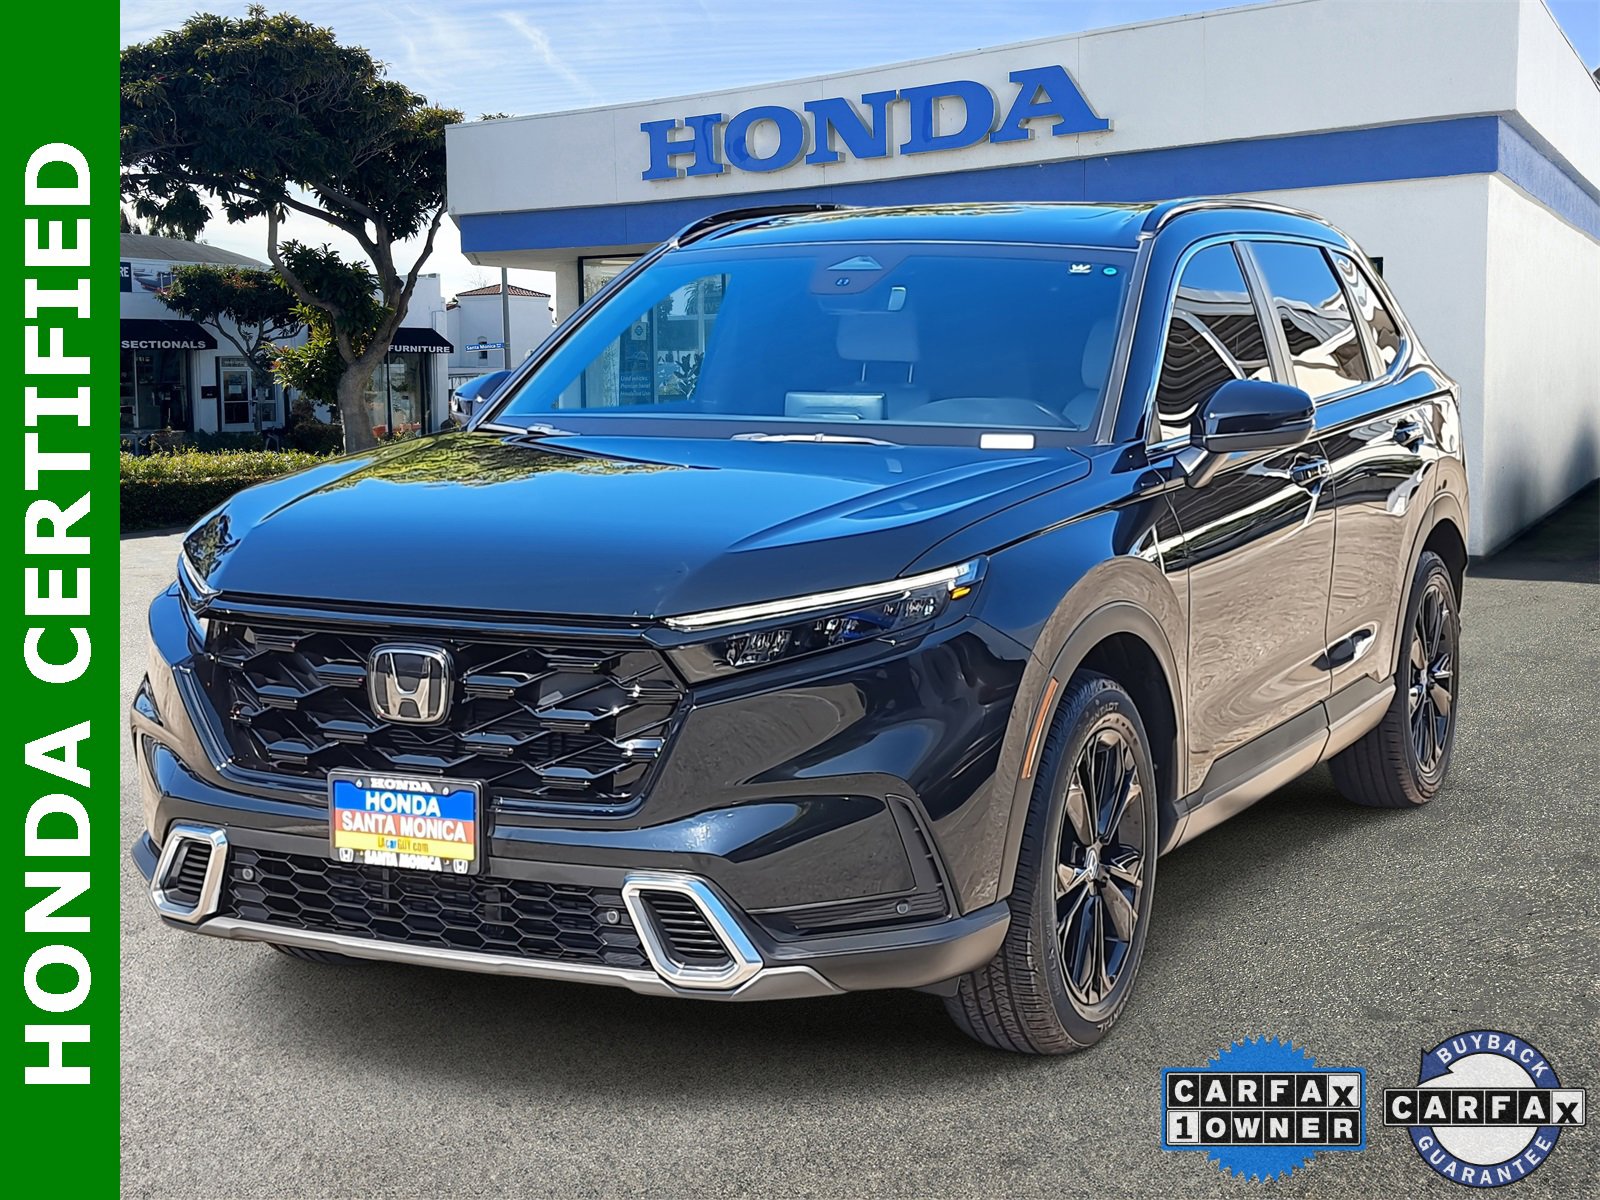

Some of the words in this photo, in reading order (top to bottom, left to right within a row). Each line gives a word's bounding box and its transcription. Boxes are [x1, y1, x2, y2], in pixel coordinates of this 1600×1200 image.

[640, 65, 1111, 181] HONDA
[121, 340, 206, 349] SECTIONALS
[388, 344, 450, 353] FURNITURE
[370, 778, 434, 793] HONDA
[365, 790, 441, 817] HONDA
[342, 811, 397, 836] SANTA
[399, 815, 467, 842] MONICA
